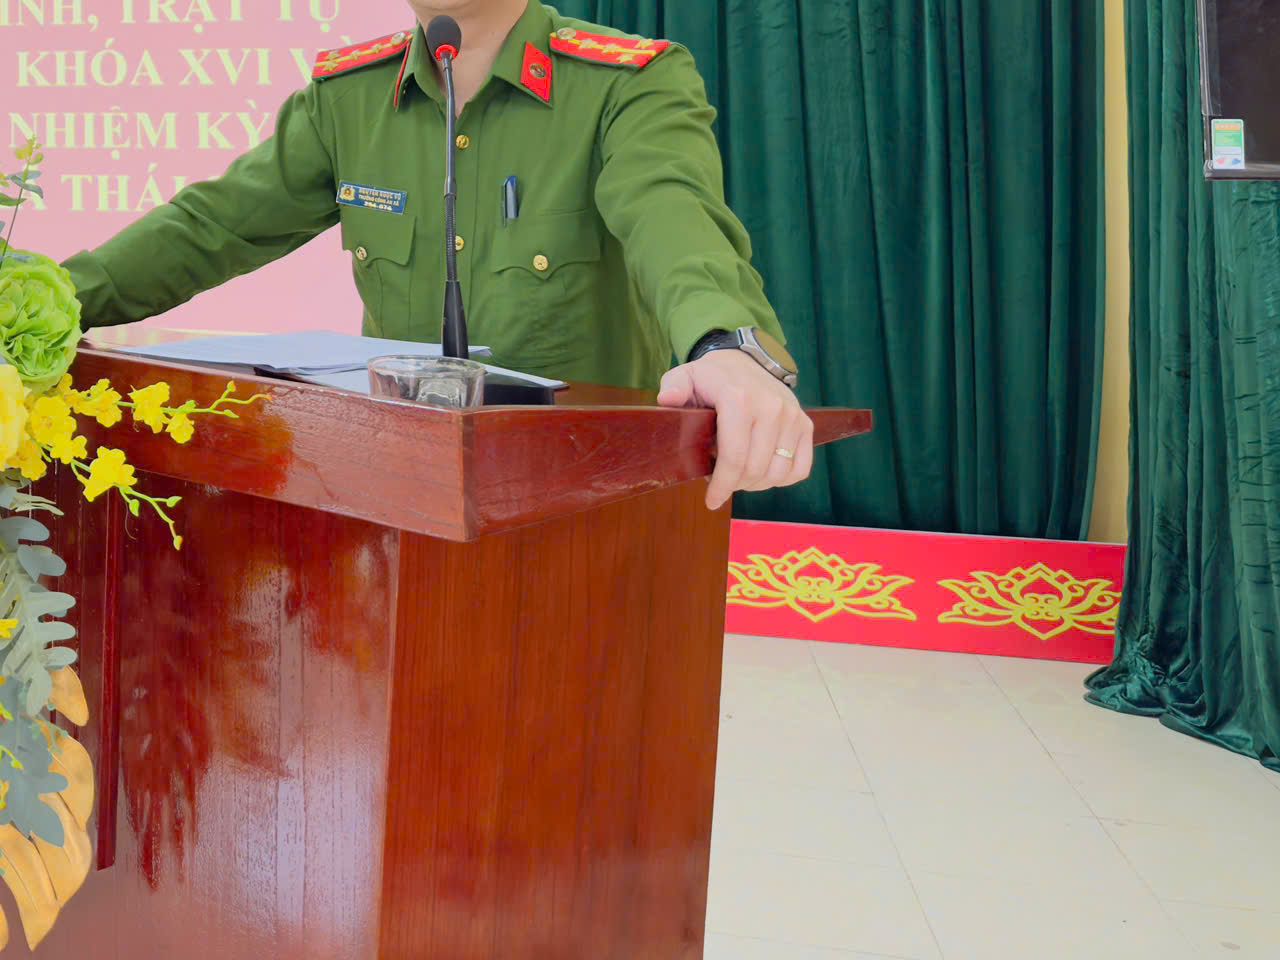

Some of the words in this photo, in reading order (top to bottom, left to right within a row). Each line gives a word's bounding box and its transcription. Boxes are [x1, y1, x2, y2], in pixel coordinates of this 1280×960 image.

[15, 38, 163, 89] KHÓA
[178, 47, 273, 85] XVI
[7, 106, 178, 161] NHIỆM
[195, 99, 273, 150] KỲ
